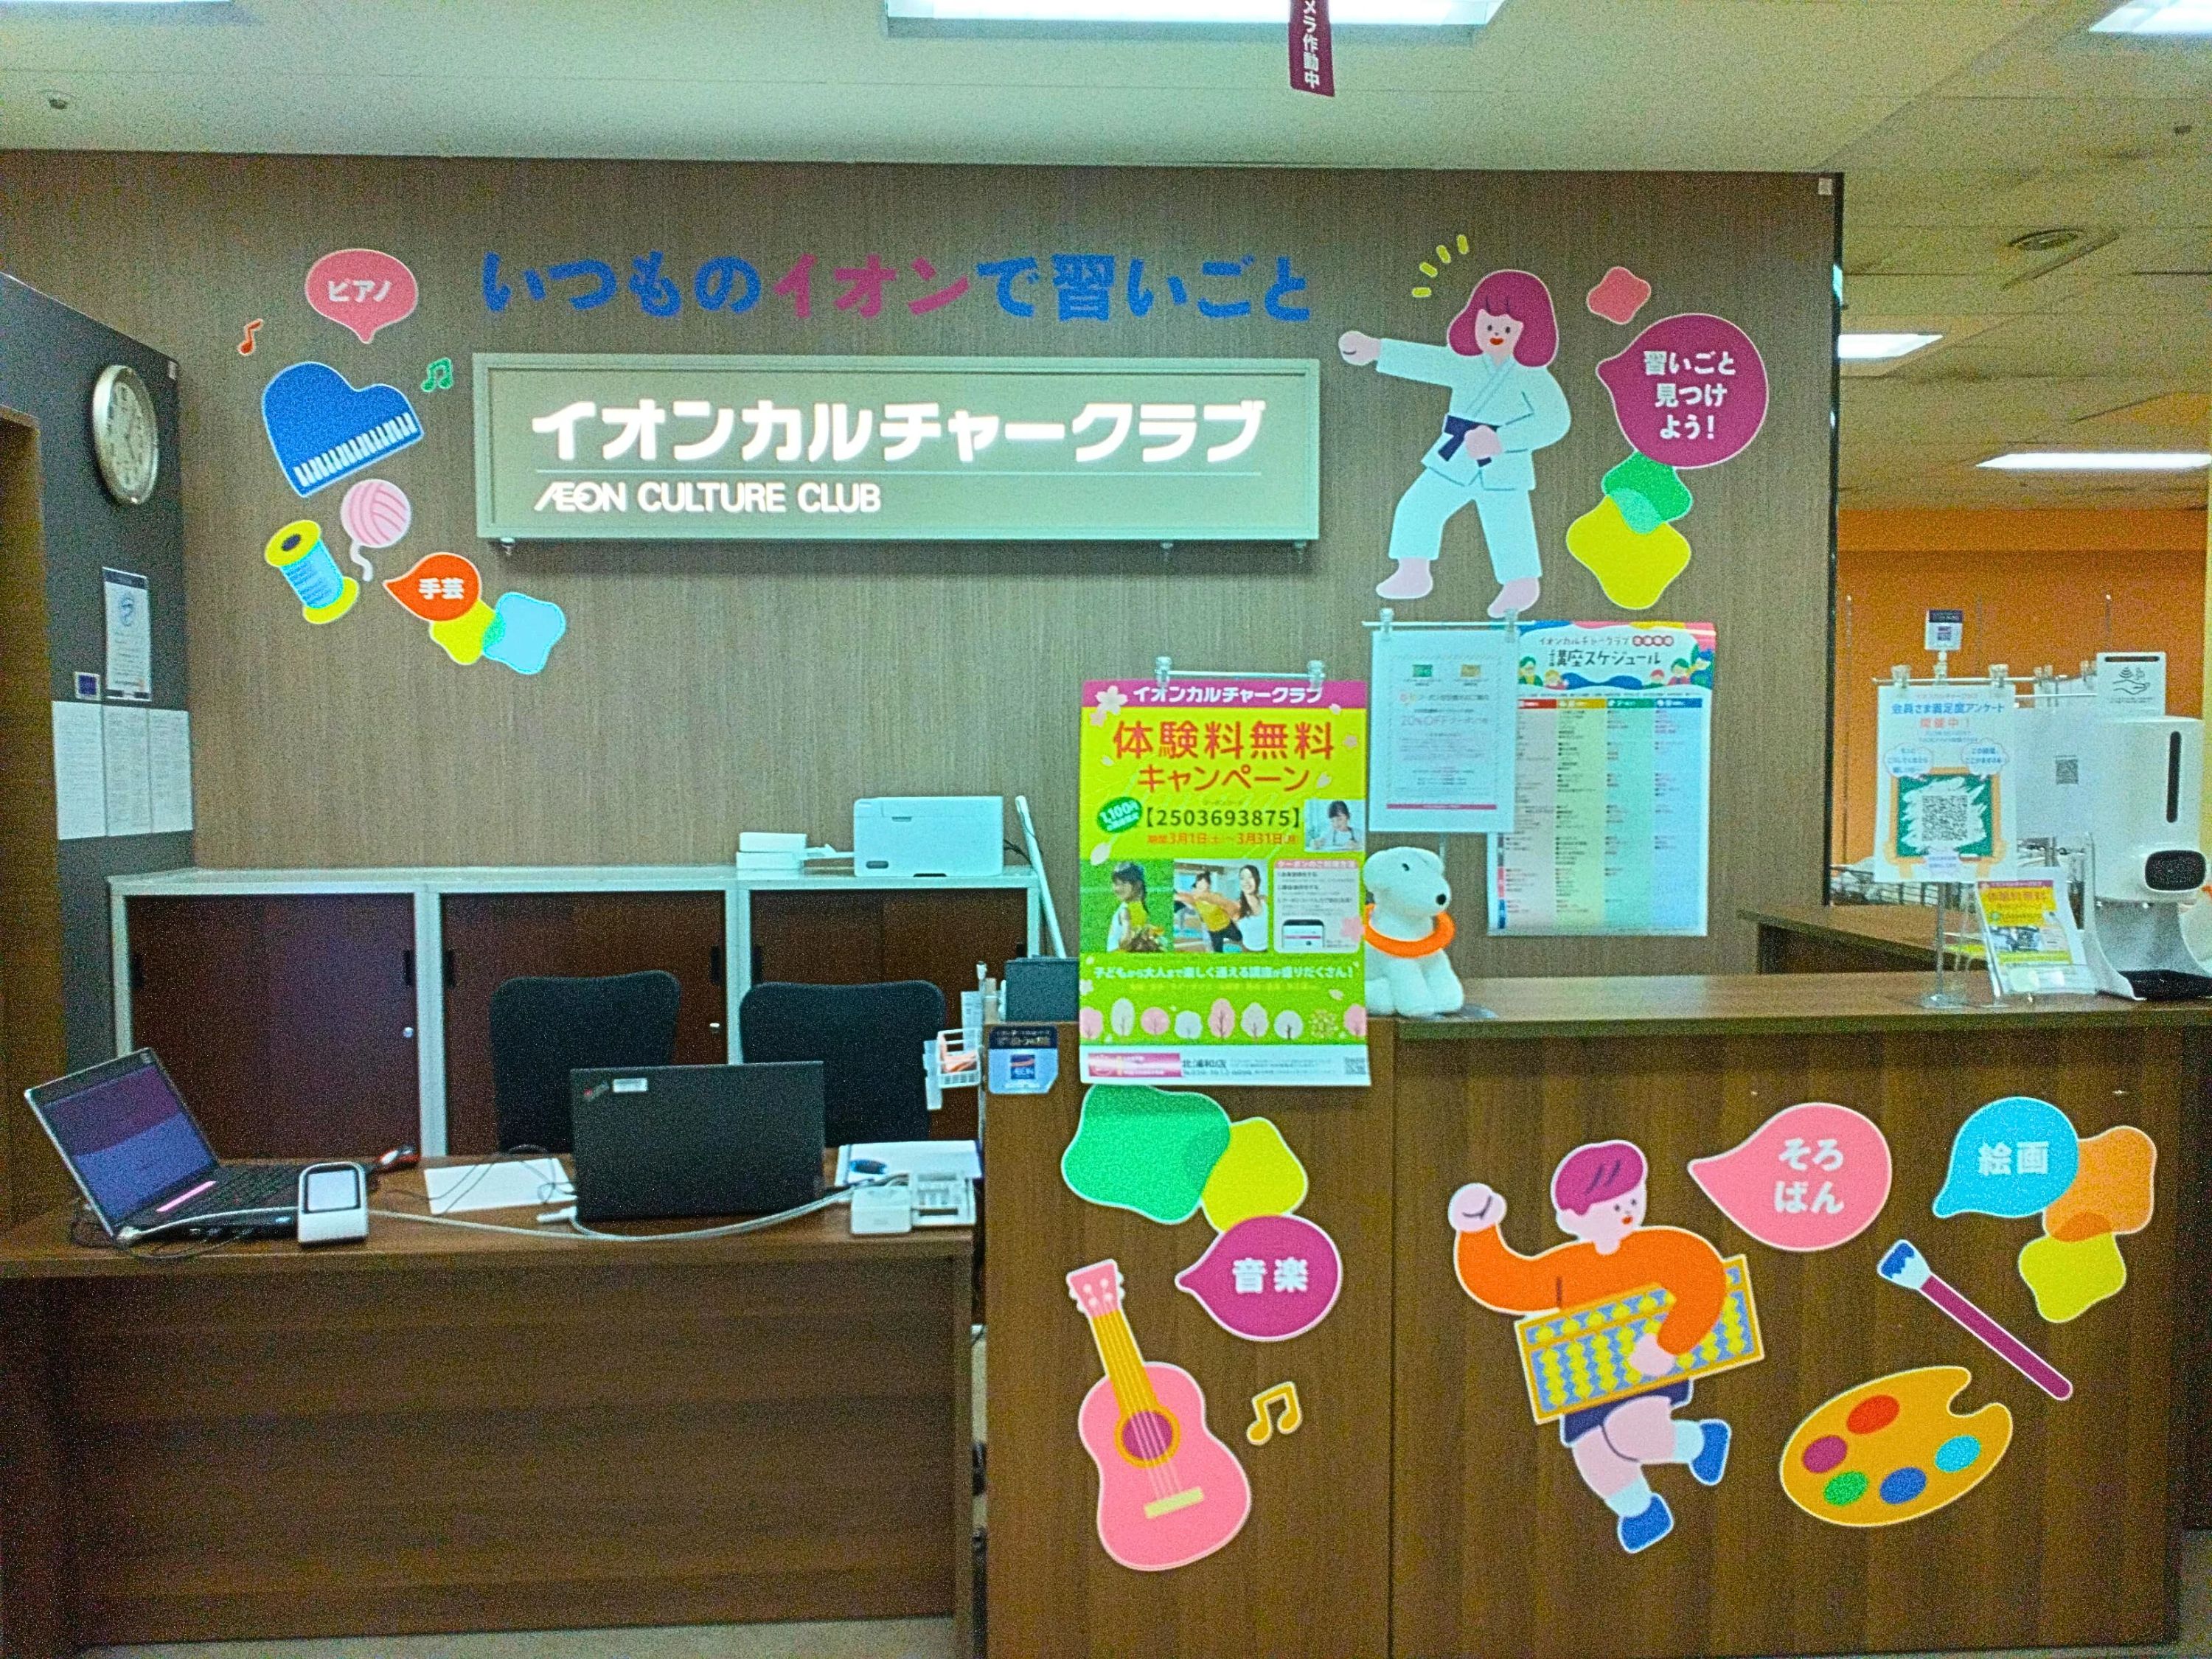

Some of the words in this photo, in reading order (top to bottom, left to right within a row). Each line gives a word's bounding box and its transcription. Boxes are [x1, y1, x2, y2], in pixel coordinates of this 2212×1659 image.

[327, 279, 392, 302] ピアノ
[481, 249, 1310, 322] いつものイオンで習いごと
[1644, 350, 1736, 375] 習いごと
[1655, 383, 1727, 407] 見つけ
[532, 399, 1266, 462] イオンカルチャークラブ
[637, 481, 786, 513] CULTURE
[797, 481, 881, 513] CLUB
[419, 577, 465, 600] 手芸
[1549, 650, 1661, 667] 講座スケジュール
[1113, 720, 1335, 760] 体験料無料
[1138, 764, 1310, 793] キャンペーン
[1778, 1138, 1843, 1172] そろ
[1978, 1141, 2050, 1175] 絵画
[1774, 1181, 1844, 1214] ばん
[1232, 1256, 1308, 1294] 音楽
